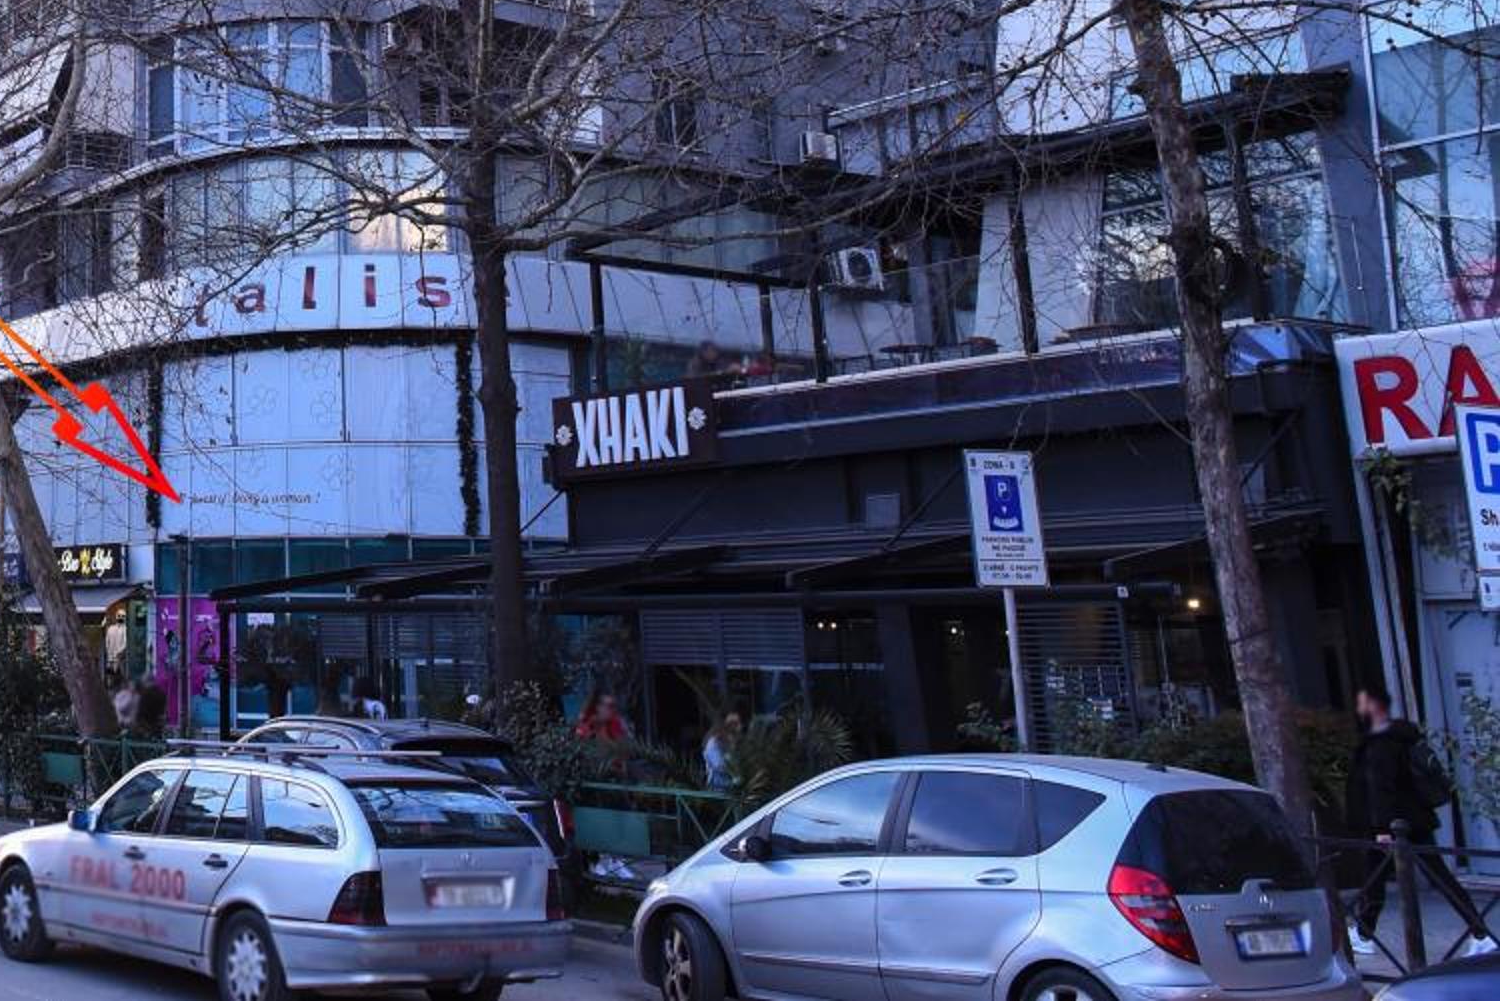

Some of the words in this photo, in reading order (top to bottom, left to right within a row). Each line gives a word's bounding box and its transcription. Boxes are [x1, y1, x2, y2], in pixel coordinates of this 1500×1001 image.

[193, 263, 511, 327] talis
[572, 387, 690, 467] XHAKI
[997, 482, 1008, 498] P
[130, 862, 186, 901] 2000
